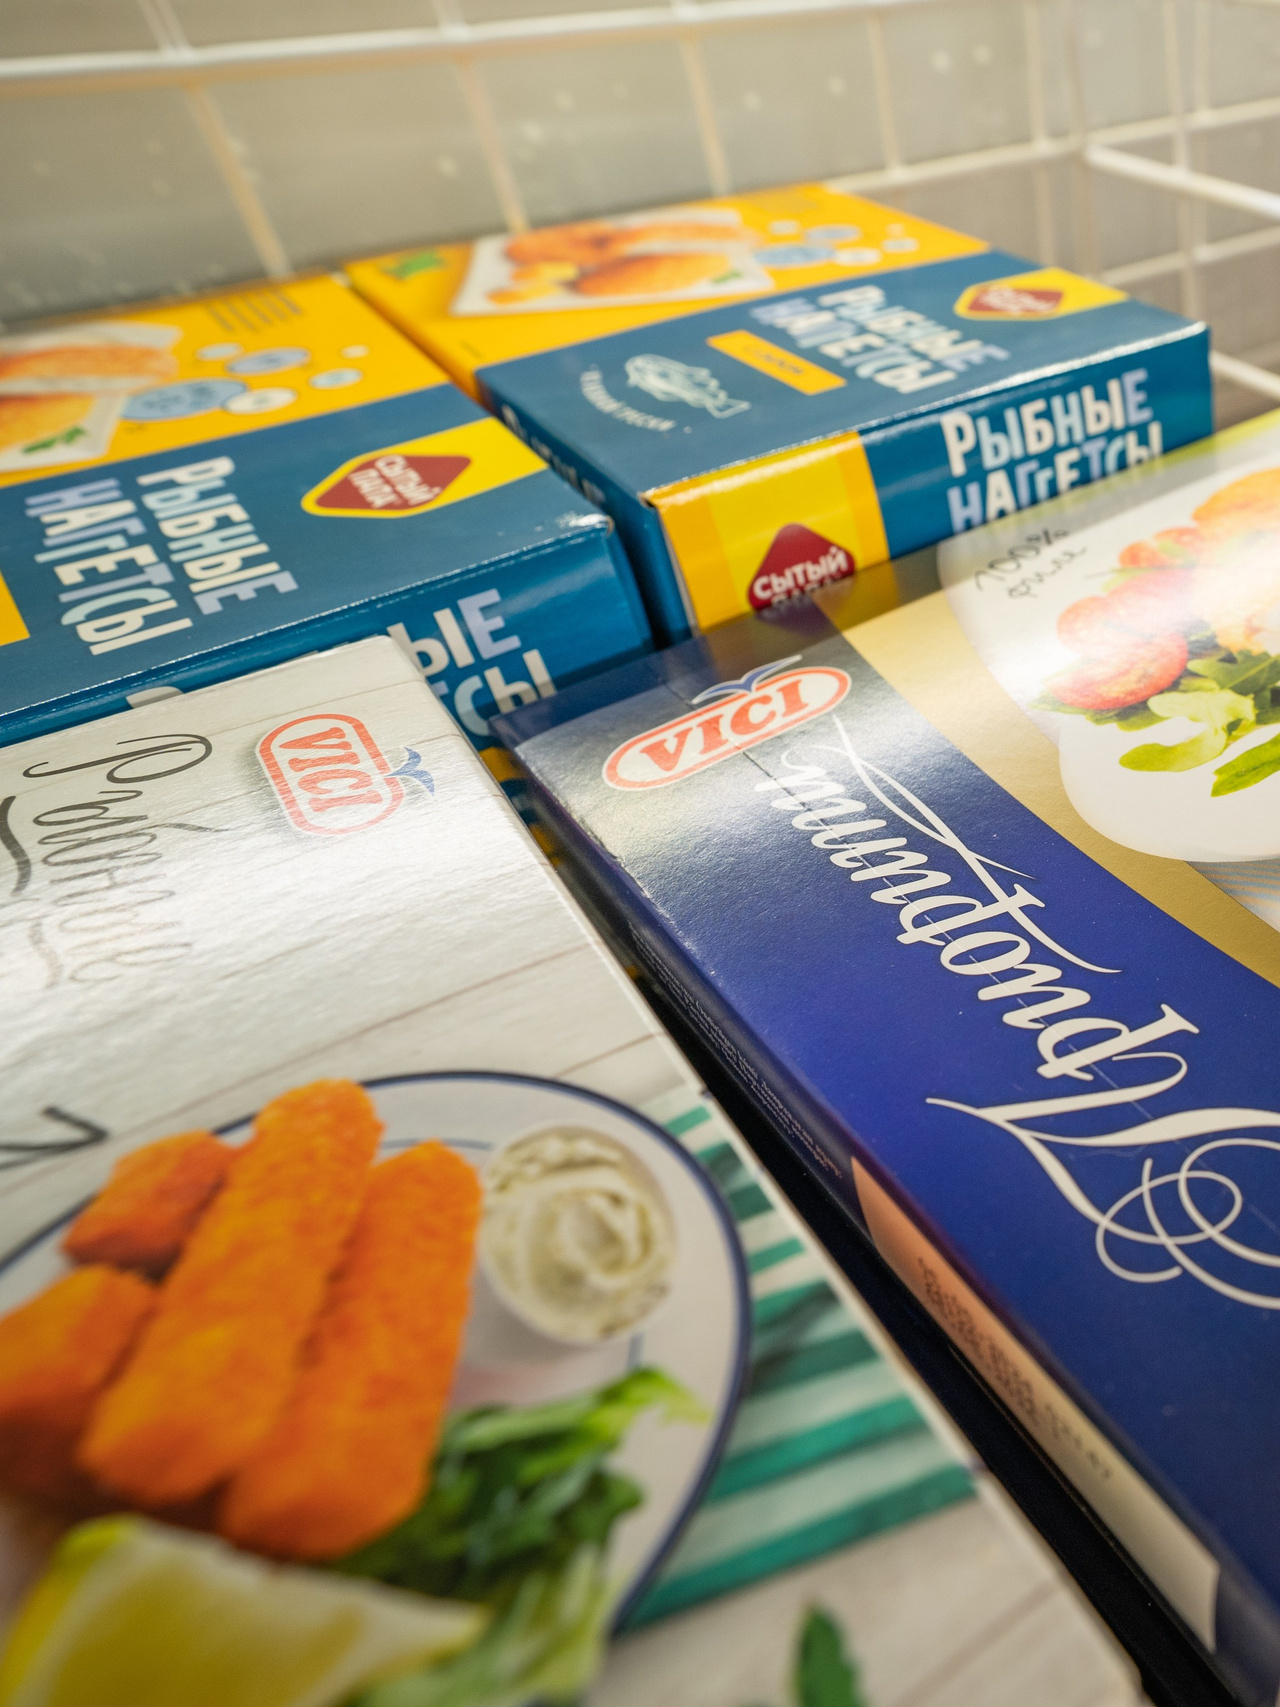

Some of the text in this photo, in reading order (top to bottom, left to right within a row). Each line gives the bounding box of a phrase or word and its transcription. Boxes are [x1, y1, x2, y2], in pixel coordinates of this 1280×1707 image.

[940, 368, 1153, 477] РЫБНЫЕ
[136, 456, 299, 615] РЫБНЫЕ
[753, 546, 849, 601] СЫТЫЙ
[974, 527, 1070, 592] 100%
[278, 726, 384, 813] VICI
[639, 678, 809, 772] VICI
